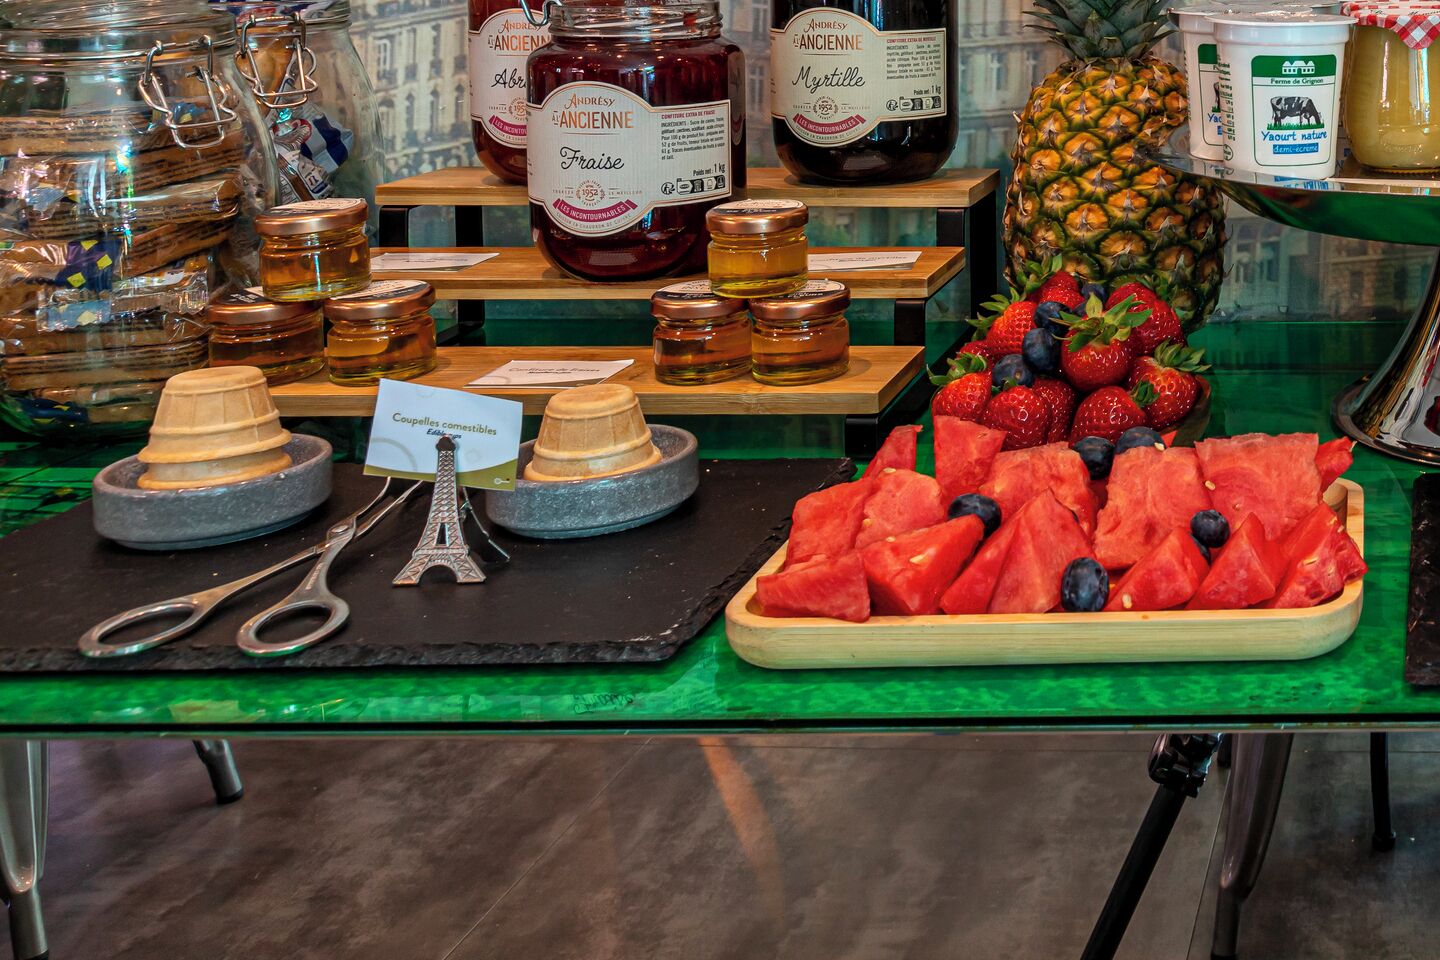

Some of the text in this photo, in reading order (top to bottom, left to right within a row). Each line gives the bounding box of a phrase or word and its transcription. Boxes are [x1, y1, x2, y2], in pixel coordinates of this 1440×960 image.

[791, 65, 866, 94] Myrtille
[1271, 77, 1324, 87] Ferme de Grignon
[1261, 130, 1327, 141] Yaourt nature
[559, 146, 625, 170] Fraise
[693, 169, 704, 177] Poids
[718, 163, 726, 173] kg
[581, 188, 599, 198] 1952
[560, 203, 626, 221] LES INCONTOURNABLES
[392, 412, 497, 436] Coupelles comestibles
